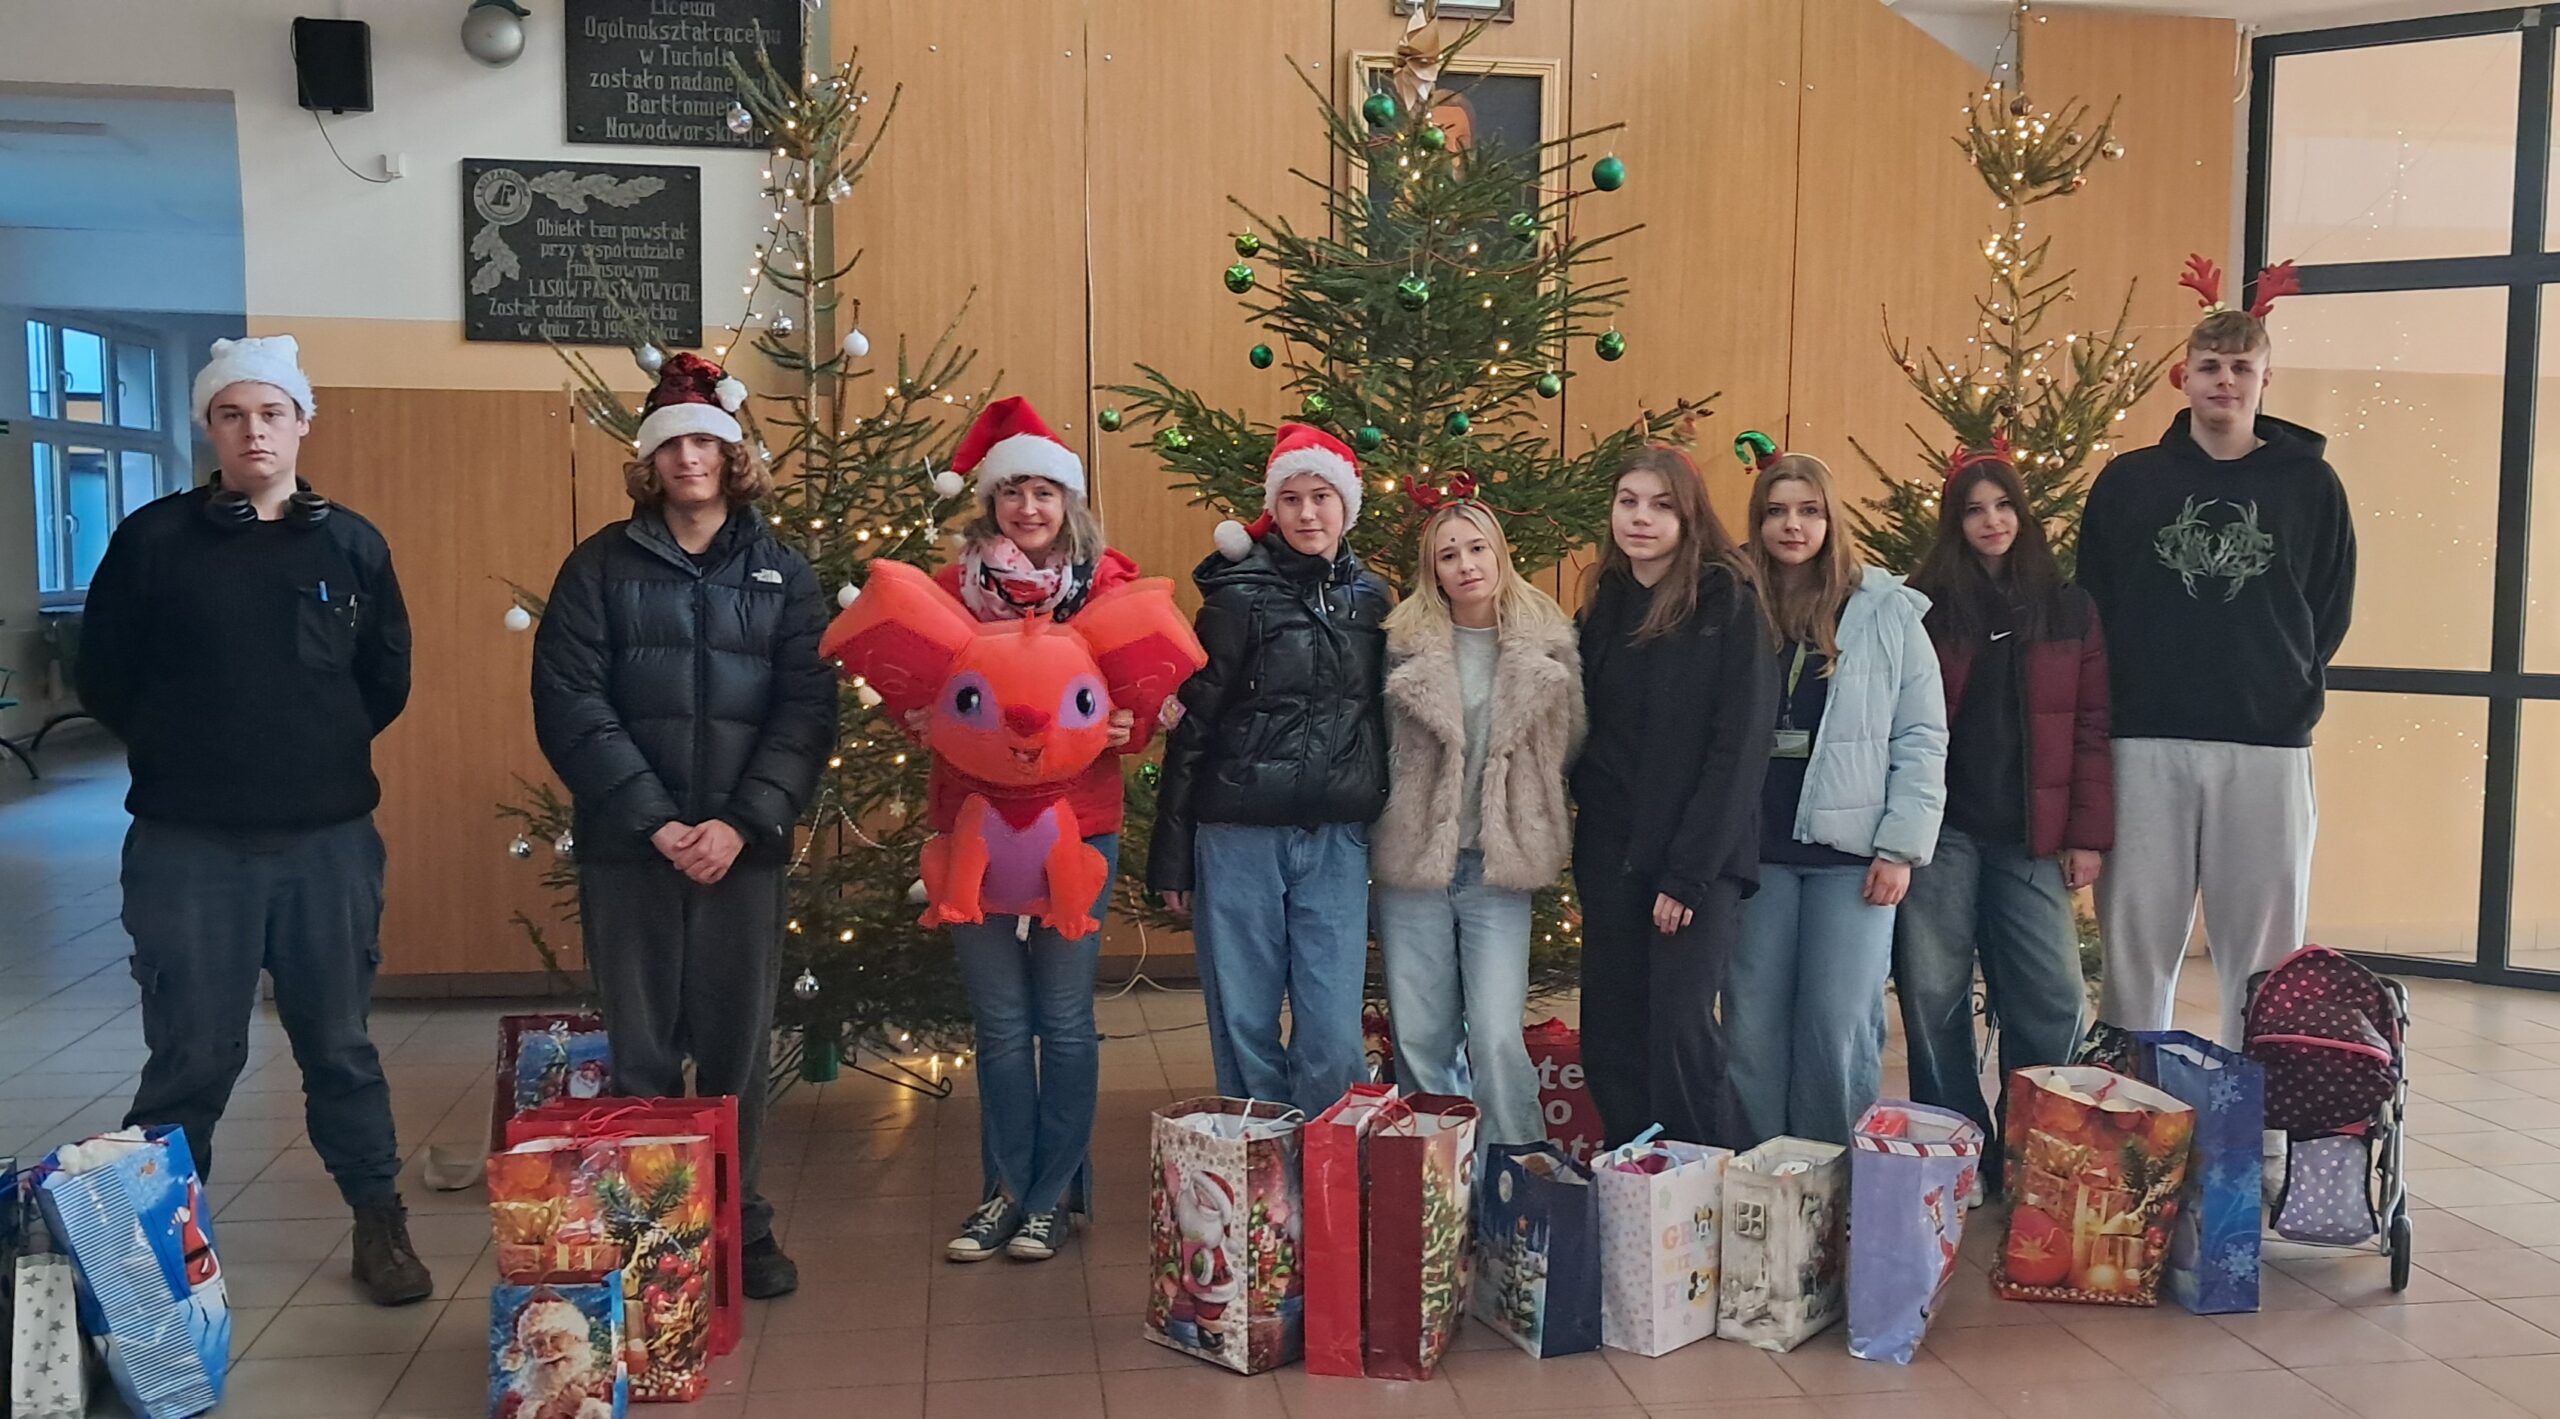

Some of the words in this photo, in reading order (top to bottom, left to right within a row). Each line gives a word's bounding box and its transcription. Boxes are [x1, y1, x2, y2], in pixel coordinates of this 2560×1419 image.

[639, 50, 653, 64] w
[590, 68, 664, 90] zostało
[670, 71, 734, 92] nadane
[536, 217, 585, 237] Obiekt
[590, 219, 617, 238] ten
[489, 298, 541, 317] Został
